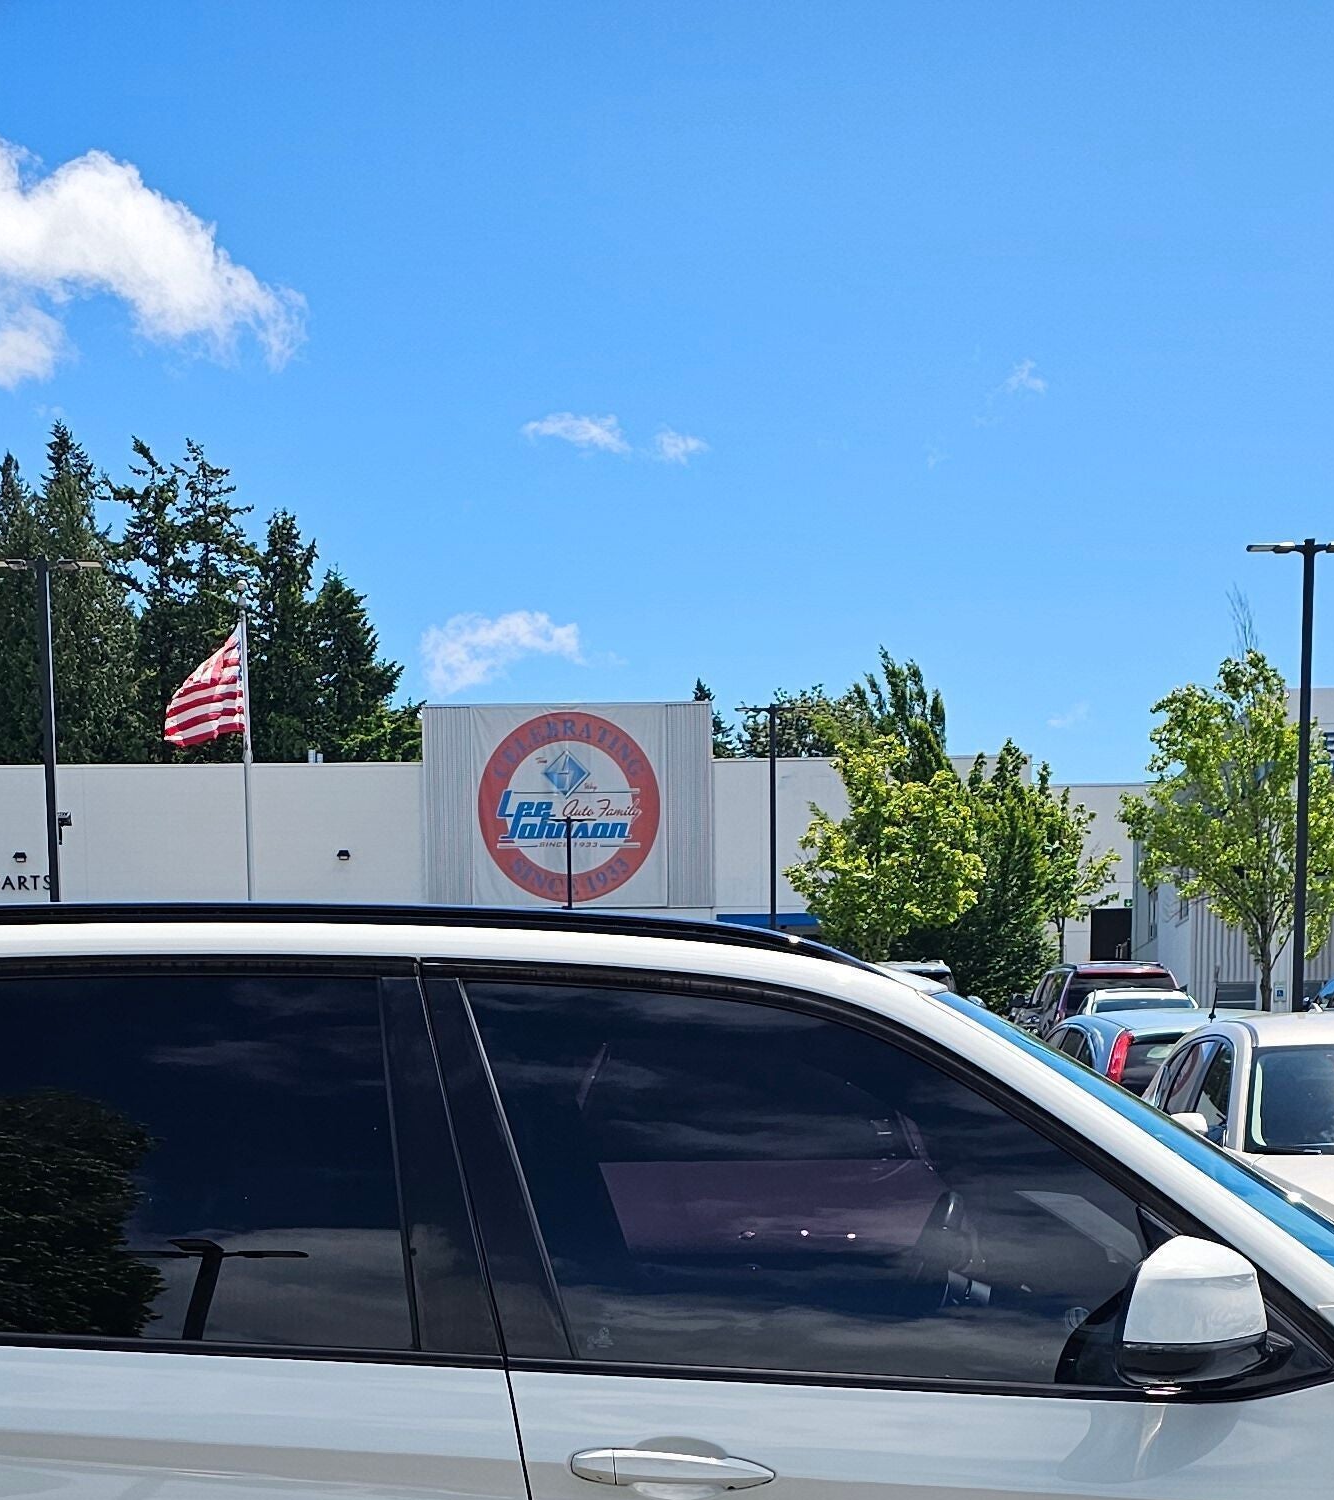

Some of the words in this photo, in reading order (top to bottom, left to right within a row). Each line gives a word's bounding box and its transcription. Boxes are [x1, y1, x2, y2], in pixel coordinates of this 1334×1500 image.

[493, 719, 645, 779] CELEBRATING
[498, 789, 556, 818] Lee
[561, 798, 595, 818] Auto
[596, 798, 642, 820] Family
[500, 814, 632, 840] Johnson
[538, 841, 567, 849] SINC
[573, 841, 599, 849] 1933
[586, 857, 629, 893] 1933
